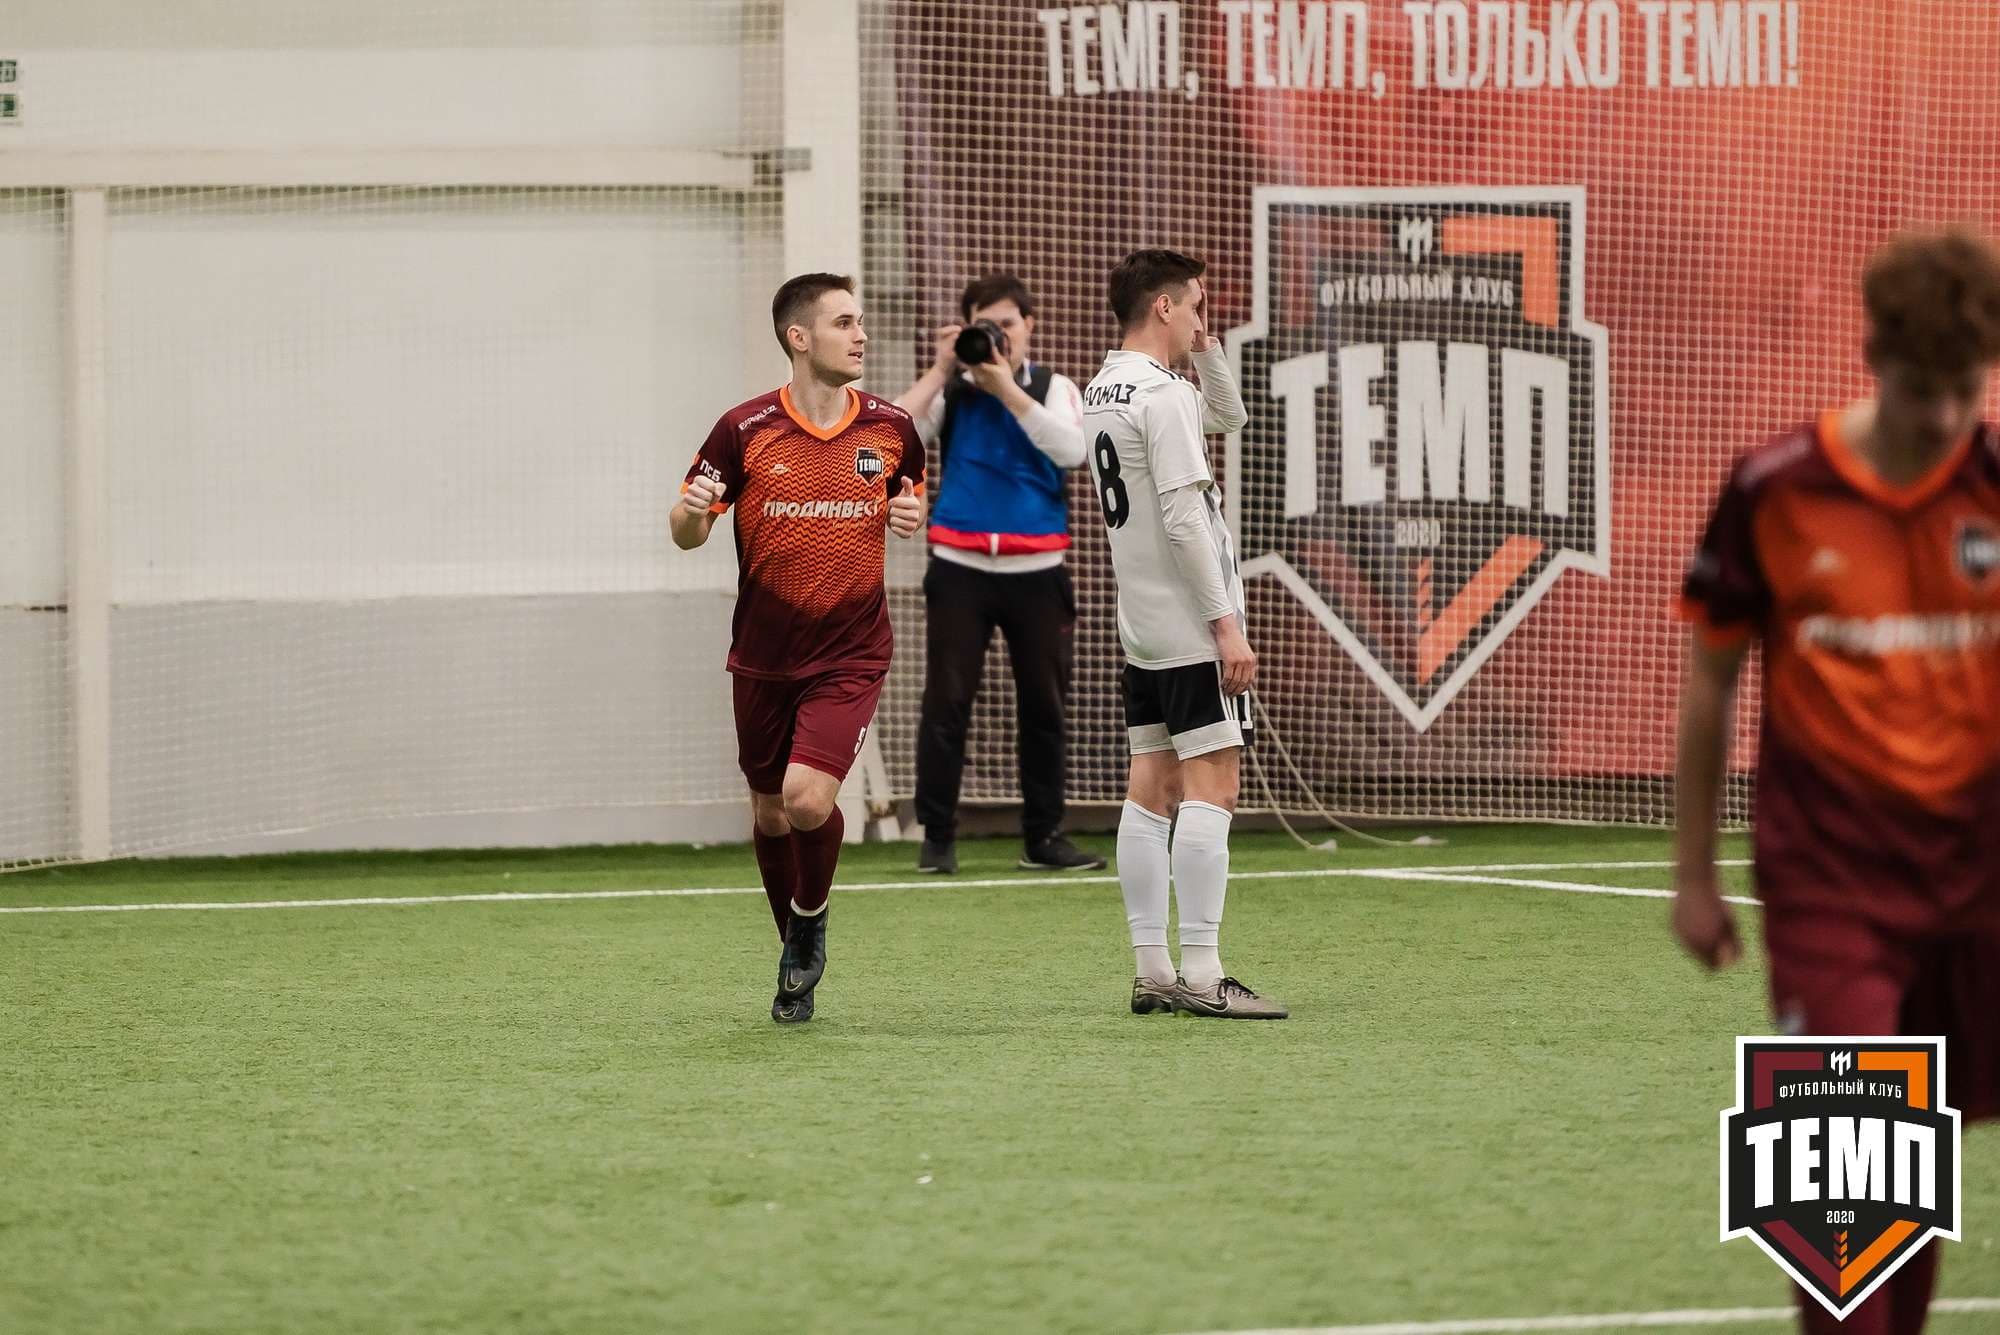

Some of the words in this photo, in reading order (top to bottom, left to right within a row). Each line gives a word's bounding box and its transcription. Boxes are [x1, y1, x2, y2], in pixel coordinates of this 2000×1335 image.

[1037, 3, 1200, 99] ТЕМП,
[1219, 1, 1386, 98] ТЕМП,
[1403, 0, 1620, 89] ТОЛЬКО
[1639, 0, 1801, 88] ТЕМП!
[1461, 275, 1514, 307] КЛУБ
[1270, 340, 1569, 519] ТЕМП
[699, 459, 722, 482] ПСБ
[858, 458, 882, 473] ТЕМП
[1095, 430, 1130, 530] 8
[1396, 519, 1441, 547] 2020
